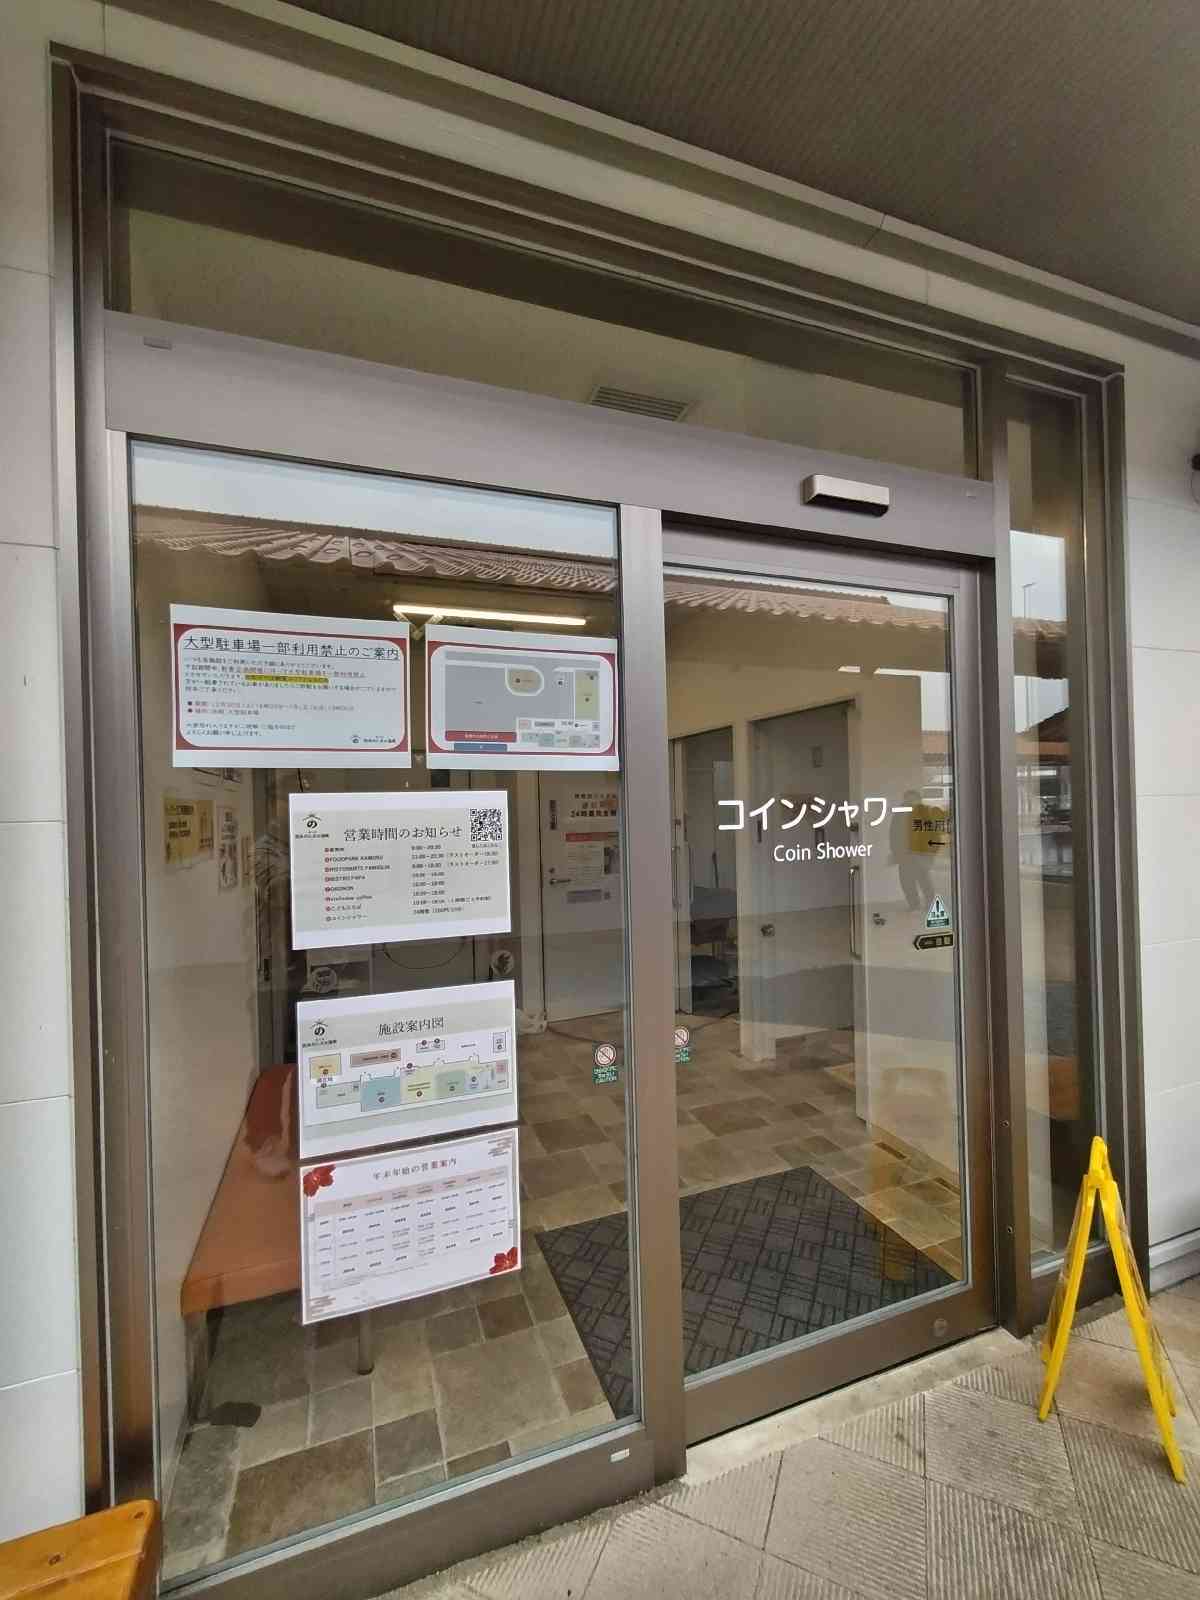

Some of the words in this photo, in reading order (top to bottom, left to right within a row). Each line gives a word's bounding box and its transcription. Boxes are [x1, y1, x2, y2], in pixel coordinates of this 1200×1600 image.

[184, 635, 399, 660] 大型駐車場一部利用禁止のご案内
[717, 797, 913, 831] コインシャワー
[344, 826, 463, 841] 営業時間のお知らせ
[773, 844, 811, 862] Coin
[817, 842, 872, 860] Shower
[377, 1016, 444, 1037] 施設案内図
